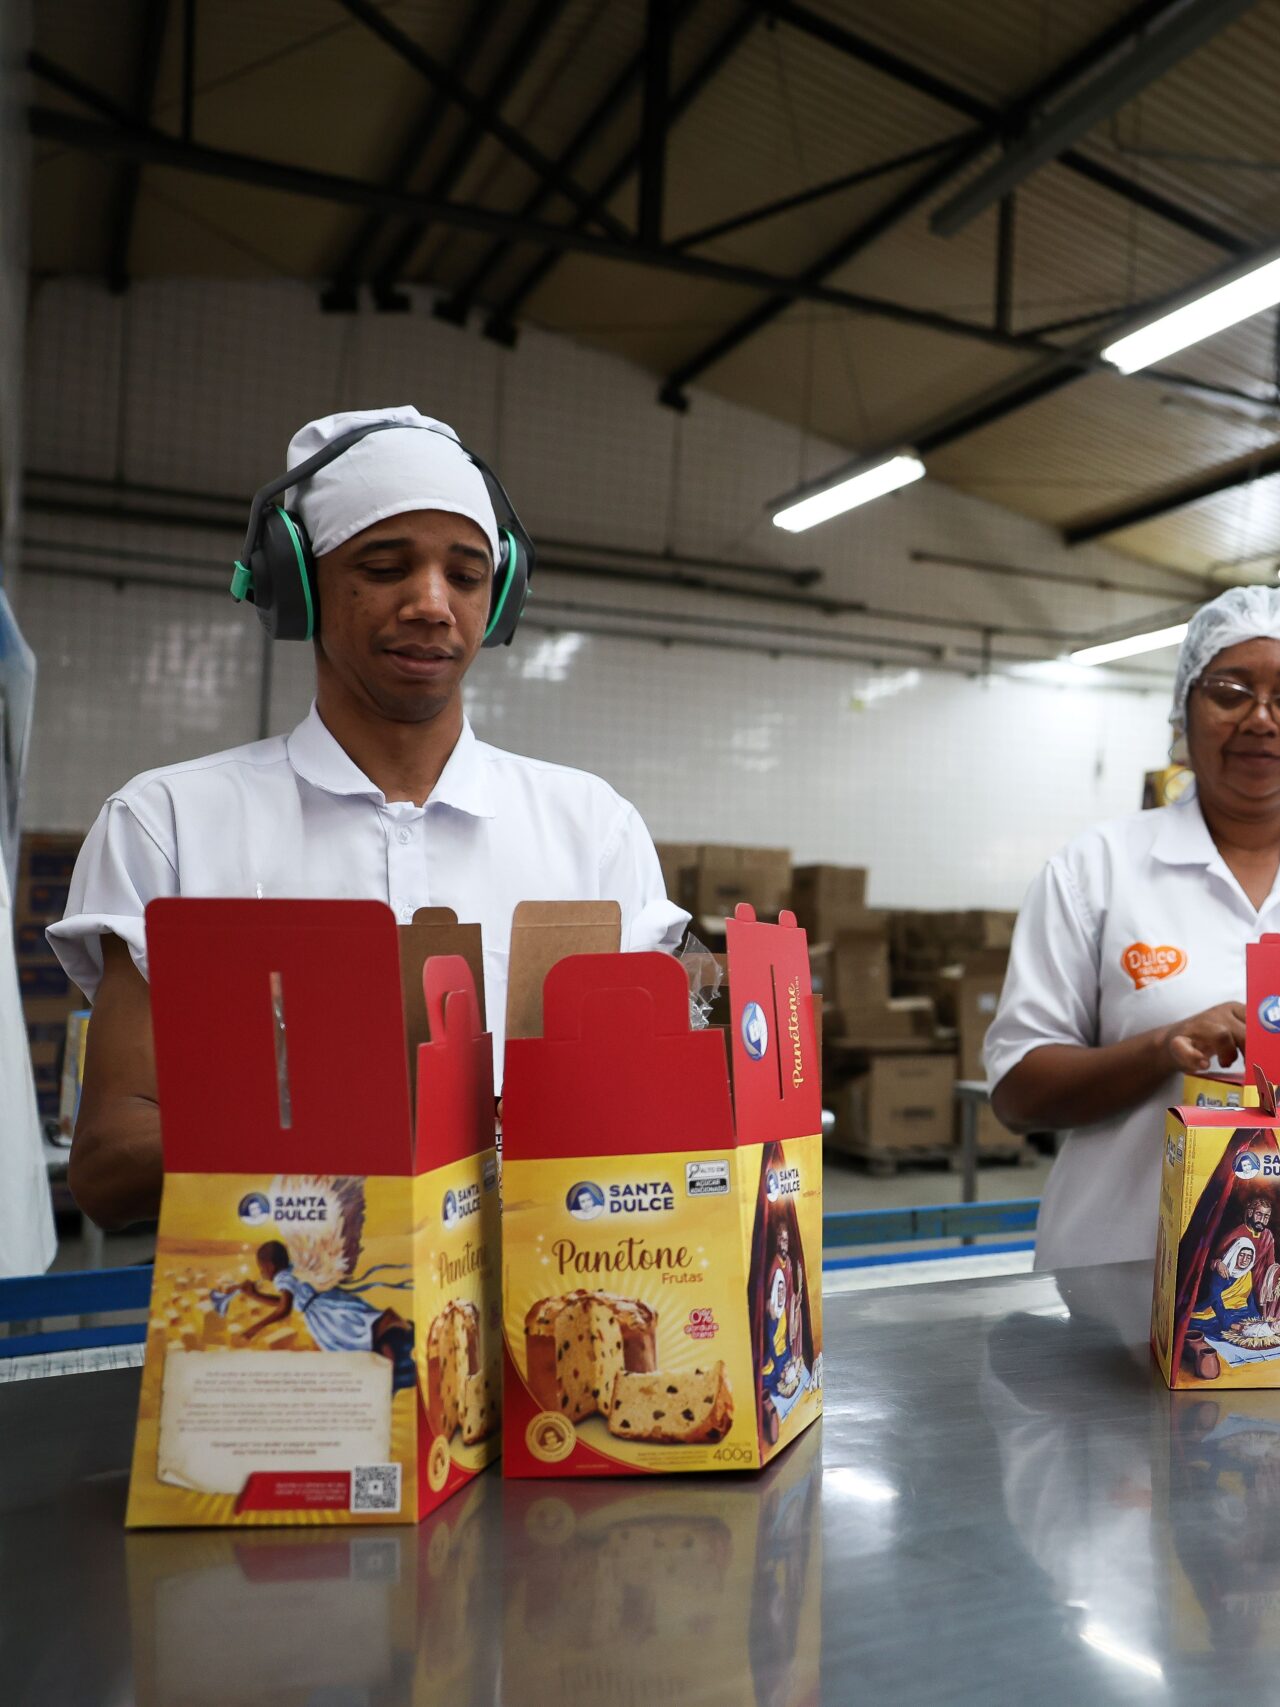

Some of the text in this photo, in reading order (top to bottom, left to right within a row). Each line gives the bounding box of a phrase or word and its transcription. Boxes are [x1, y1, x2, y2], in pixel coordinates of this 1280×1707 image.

[1128, 950, 1177, 969] Dulce
[788, 983, 804, 1089] Panetone
[780, 1168, 800, 1181] SANTA
[458, 1184, 480, 1202] SANTA
[609, 1181, 673, 1198] SANTA
[780, 1180, 801, 1195] DULCE
[275, 1196, 327, 1208] SANTA
[458, 1197, 480, 1219] DULCE
[609, 1197, 675, 1213] DULCE
[274, 1208, 328, 1221] DULCE
[552, 1237, 693, 1276] Panetone
[661, 1272, 704, 1285] Frutas
[690, 1309, 713, 1324] 0%
[712, 1448, 753, 1463] 400g
